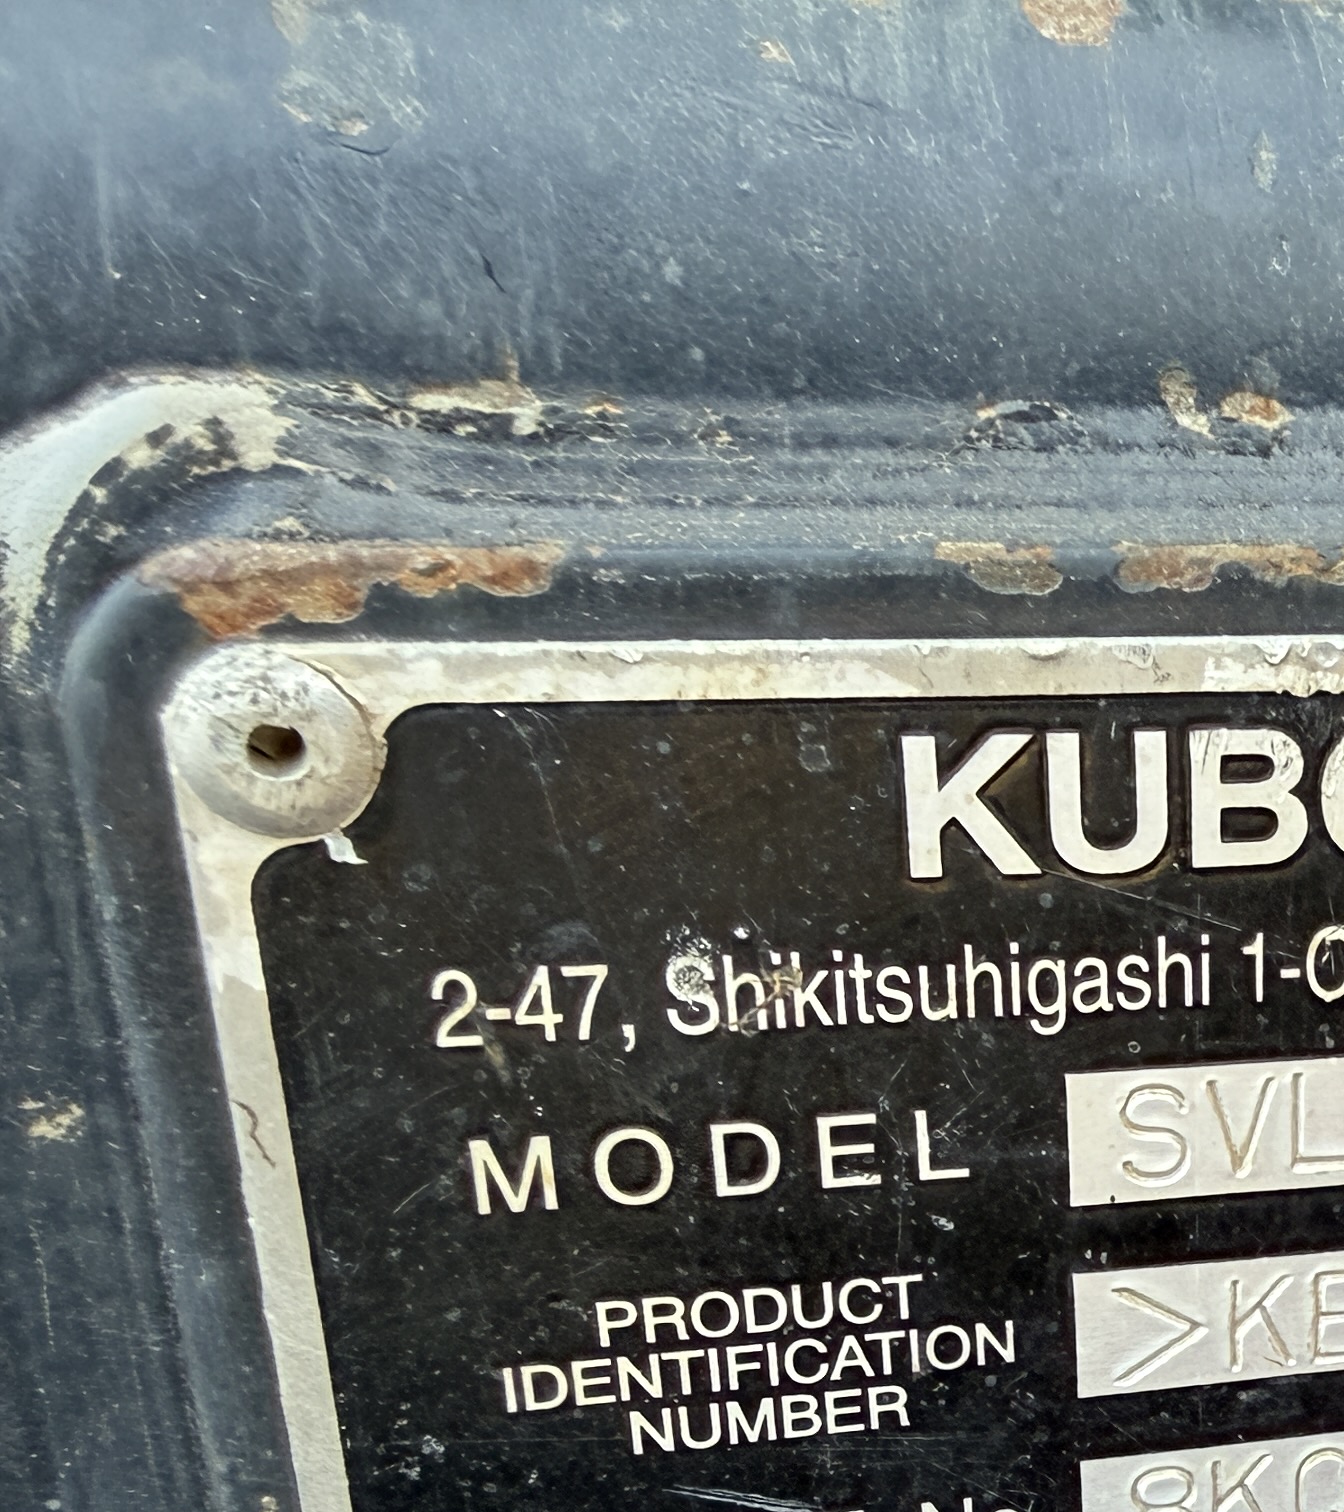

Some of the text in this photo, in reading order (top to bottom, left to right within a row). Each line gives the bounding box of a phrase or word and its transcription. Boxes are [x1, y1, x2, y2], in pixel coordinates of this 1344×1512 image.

[430, 963, 637, 1051] 2-47,
[665, 934, 1212, 1037] Shikitsuhigashi
[468, 1108, 970, 1215] MODEL
[595, 1274, 923, 1347] PRODUCT
[502, 1320, 1017, 1412] IDENTIFICATION
[629, 1385, 910, 1455] NUMBER
